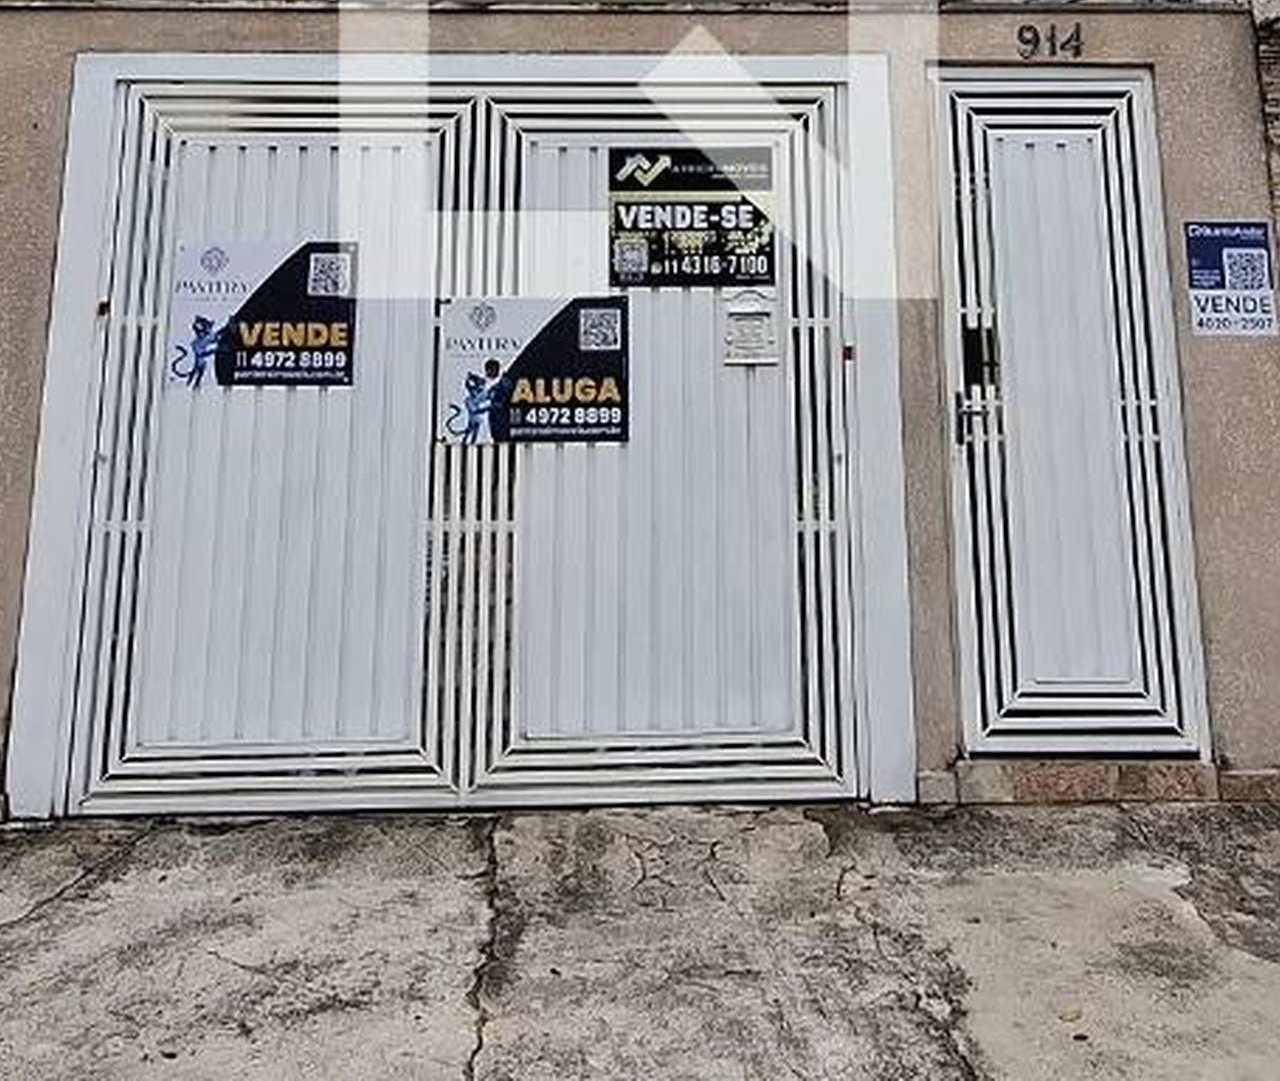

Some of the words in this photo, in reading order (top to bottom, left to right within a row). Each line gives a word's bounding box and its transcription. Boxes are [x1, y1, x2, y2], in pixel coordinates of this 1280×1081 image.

[1017, 22, 1085, 59] 914
[618, 204, 754, 229] VENDE-SE
[664, 259, 678, 274] 11
[681, 255, 768, 274] 4316-7100
[1193, 295, 1271, 314] VENDE
[239, 322, 349, 347] VENDE
[251, 351, 296, 368] 4972
[299, 351, 347, 368] 8899
[510, 377, 621, 404] ALUGA
[525, 407, 571, 424] 4972
[574, 407, 622, 424] 8899
